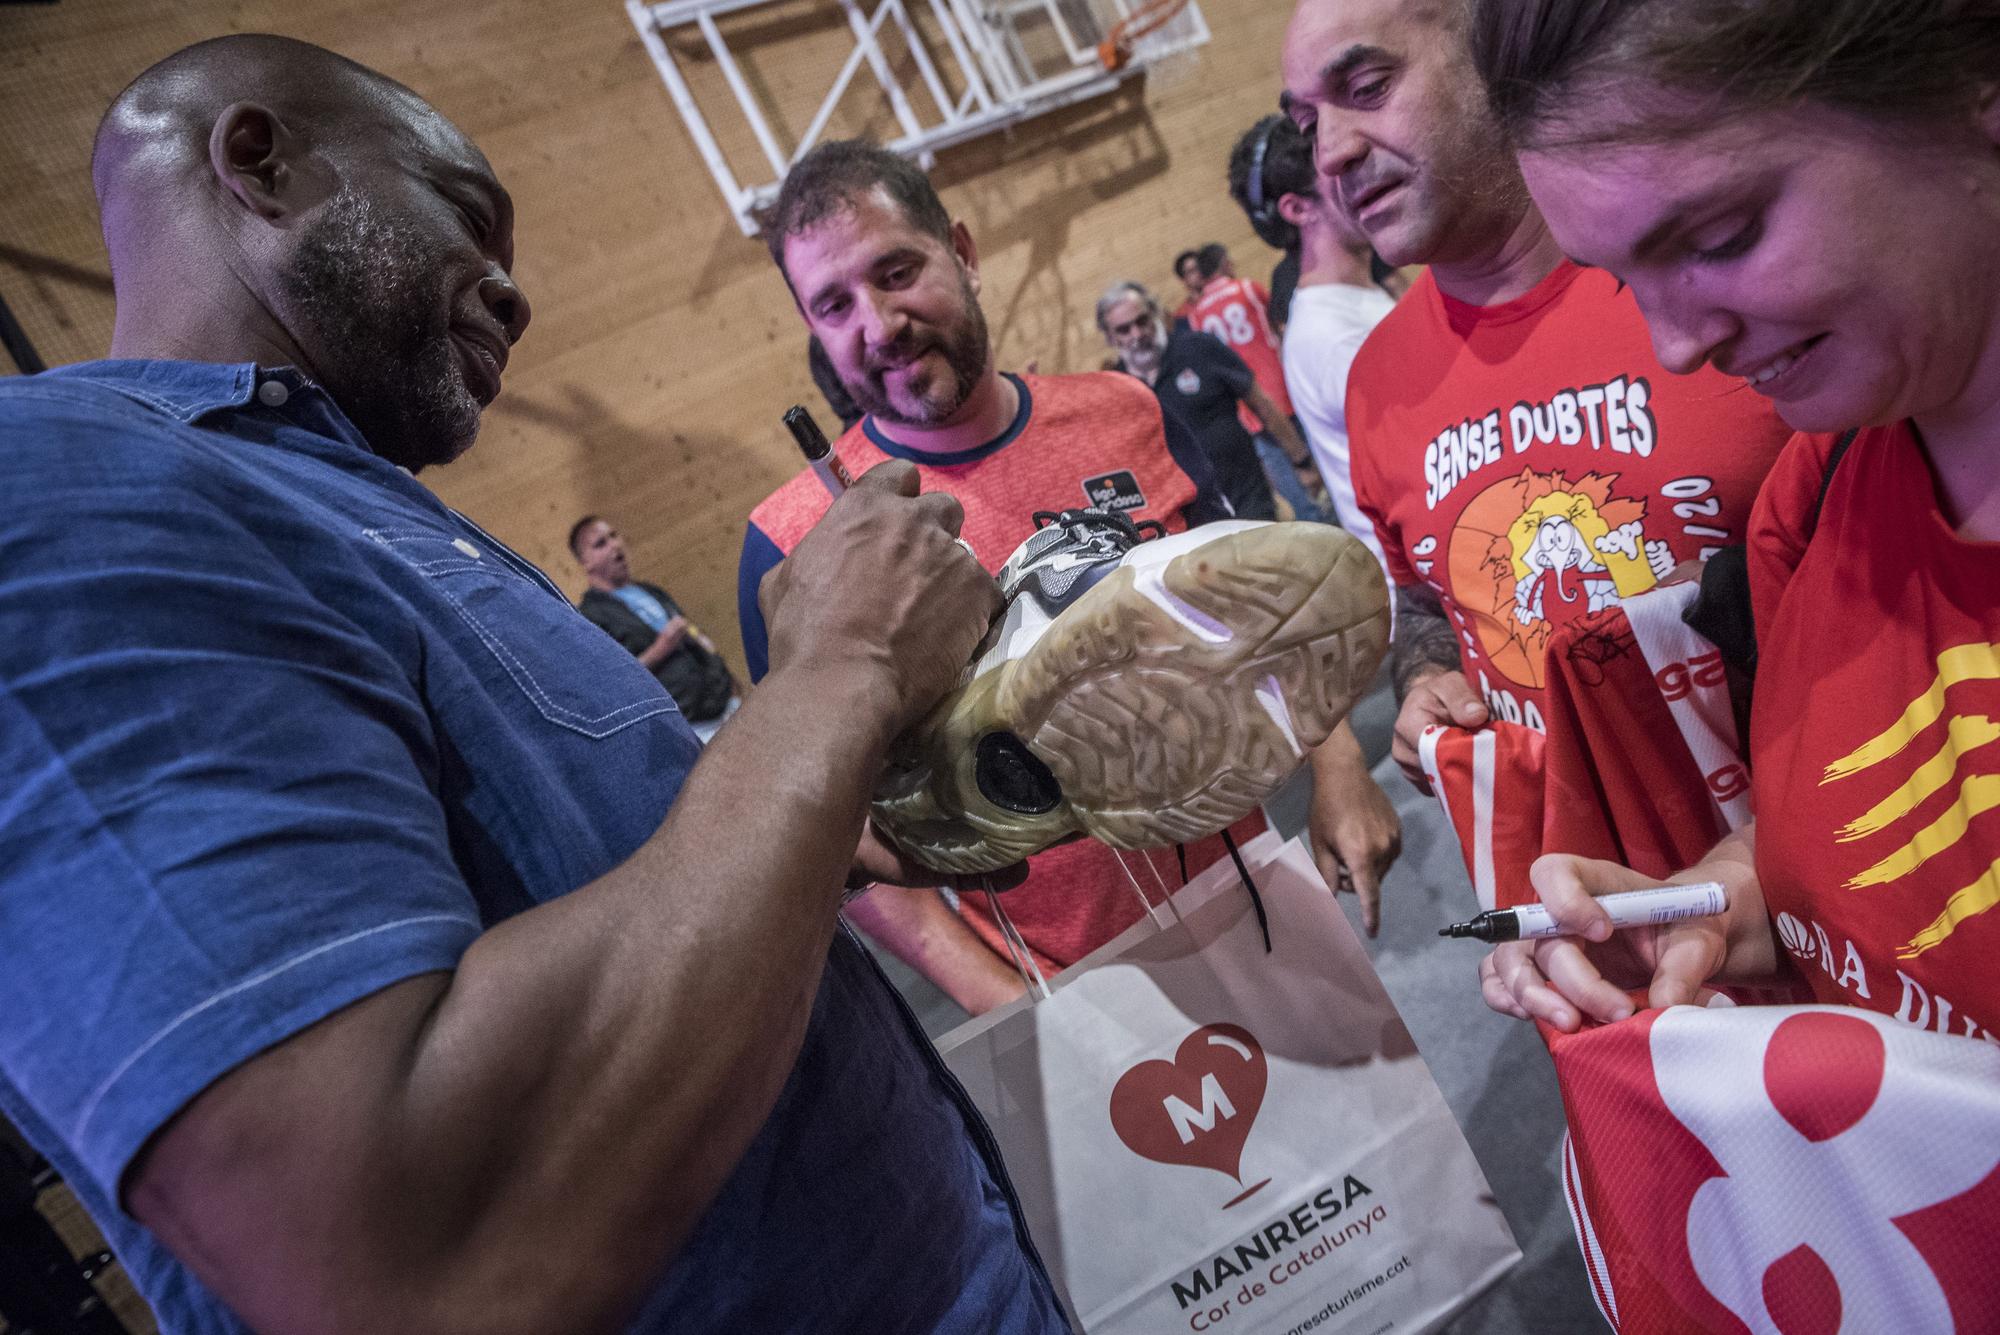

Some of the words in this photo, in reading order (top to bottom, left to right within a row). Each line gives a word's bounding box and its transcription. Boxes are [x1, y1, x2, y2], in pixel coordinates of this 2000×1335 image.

[1424, 409, 1503, 511] SENSE
[1508, 375, 1657, 459] DUBTES
[1162, 1072, 1237, 1145] M
[1170, 1174, 1374, 1310] MANRESA
[1189, 1300, 1233, 1333] Cor
[1236, 1281, 1267, 1307] de
[1268, 1204, 1388, 1285] Catalunya
